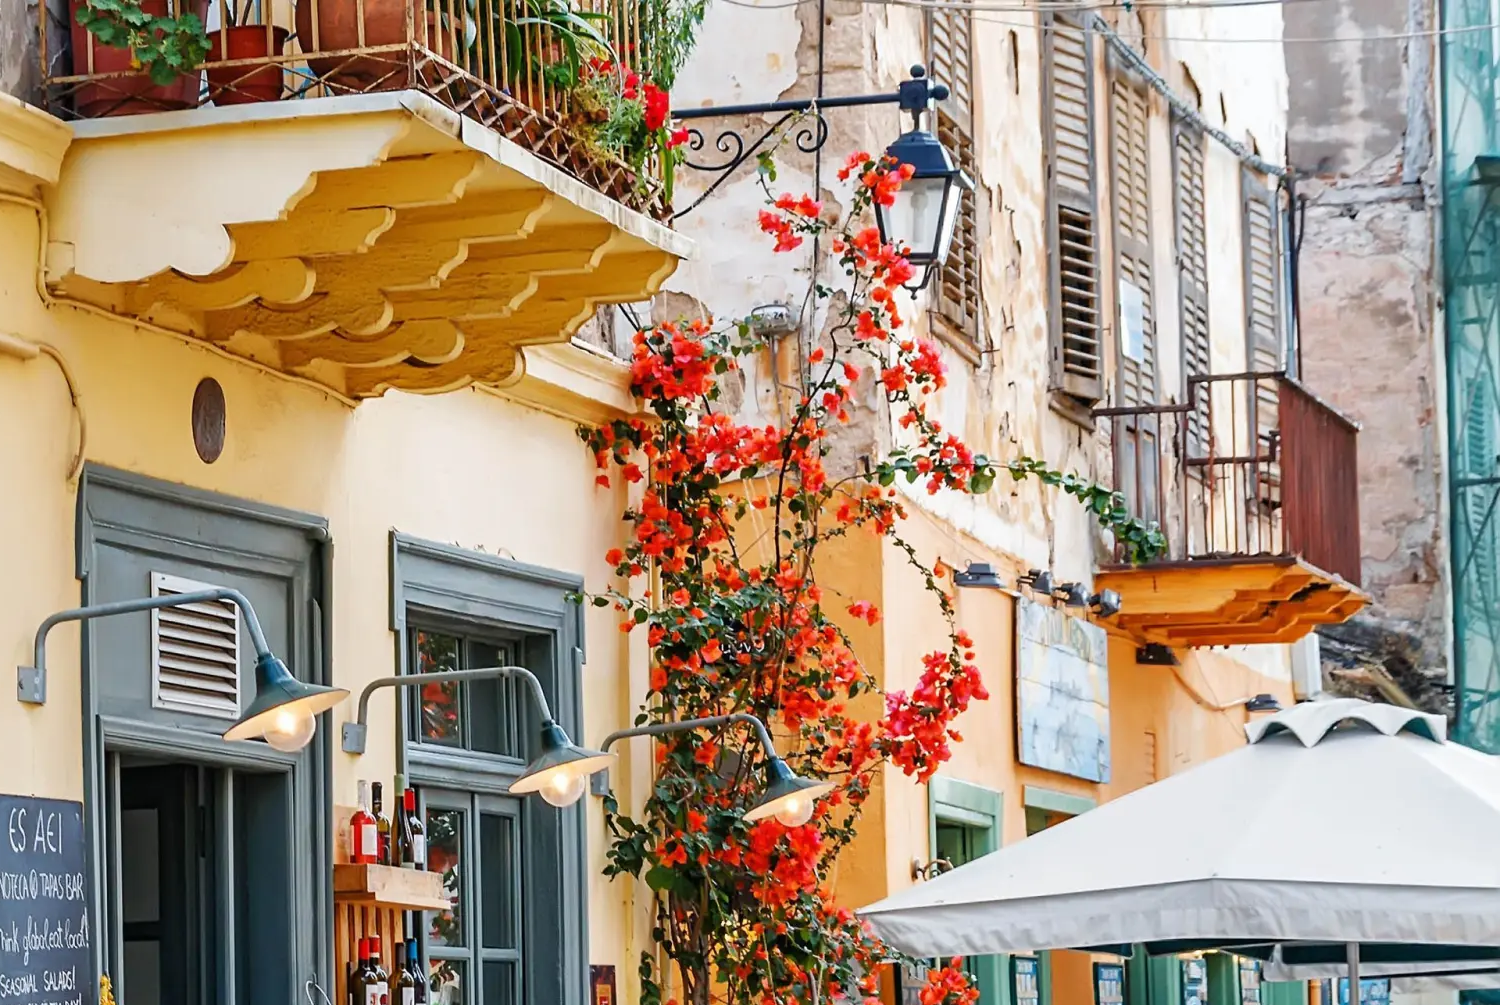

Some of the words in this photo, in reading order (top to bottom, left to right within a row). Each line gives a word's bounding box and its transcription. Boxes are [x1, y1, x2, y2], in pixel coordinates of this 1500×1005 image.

[9, 807, 27, 854] ES
[40, 872, 64, 900] TAPAS
[65, 872, 85, 901] BAR
[0, 973, 38, 998] SEASONAL
[43, 965, 76, 992] SALADS!
